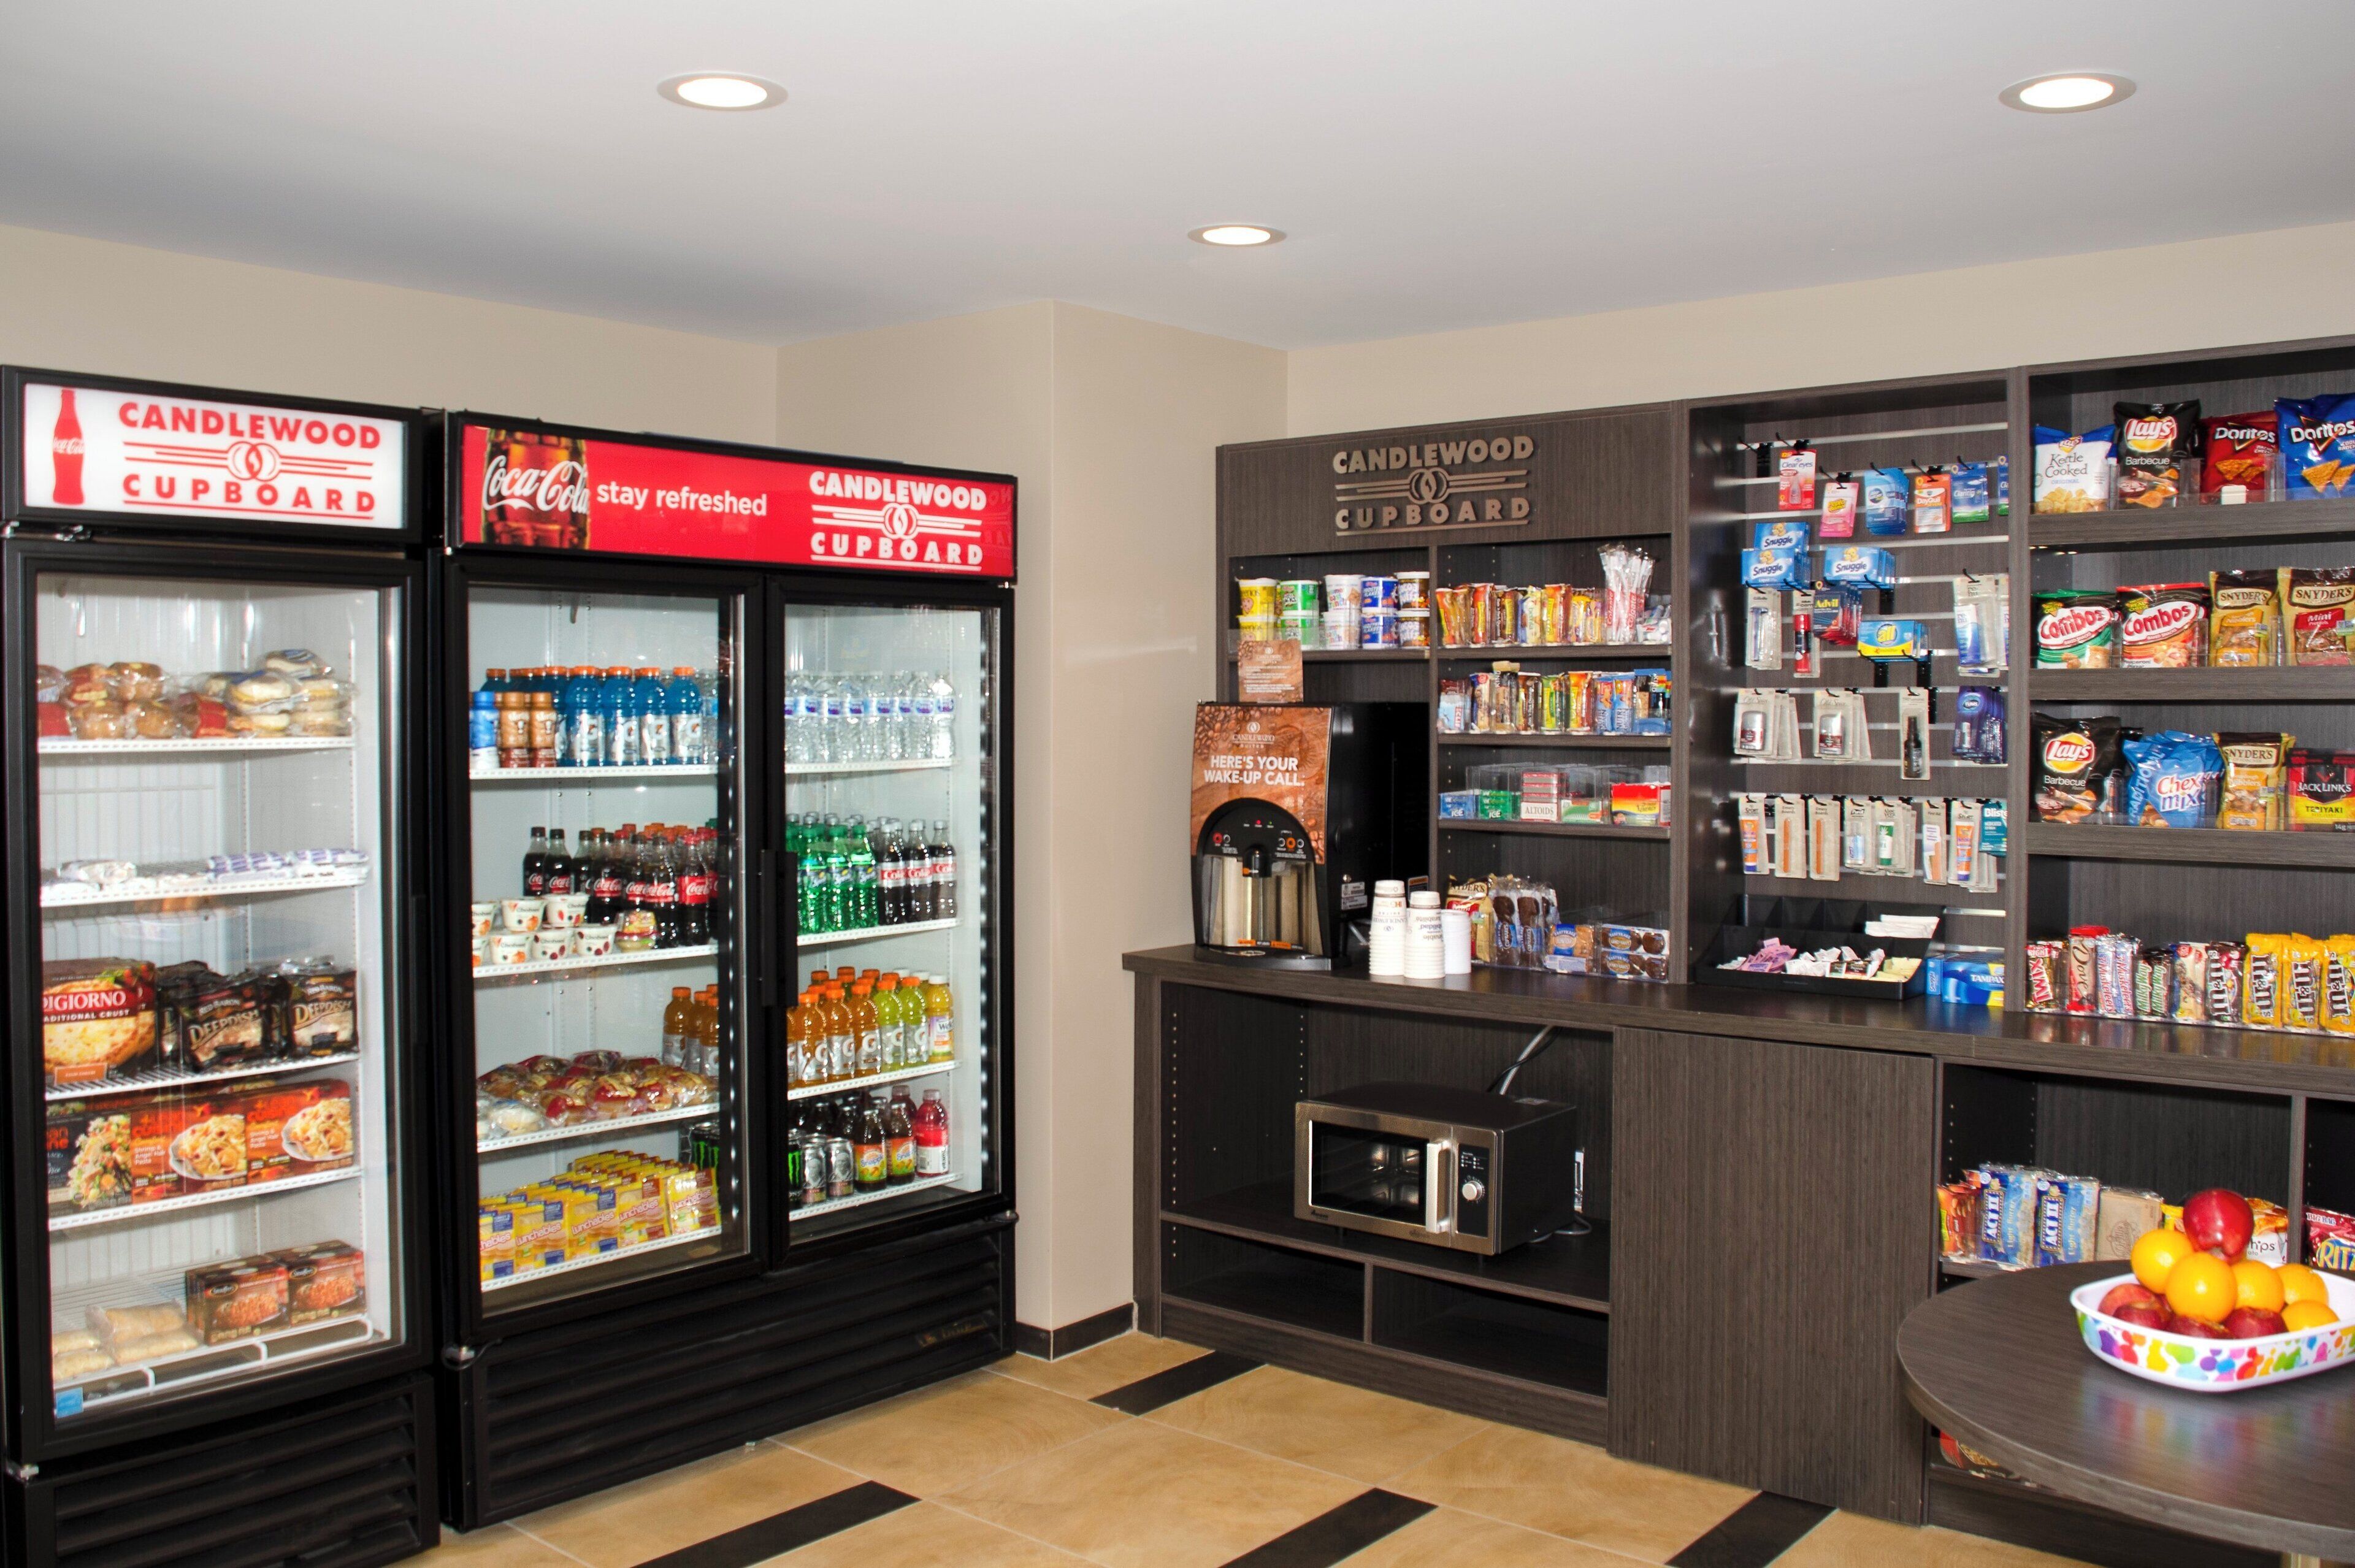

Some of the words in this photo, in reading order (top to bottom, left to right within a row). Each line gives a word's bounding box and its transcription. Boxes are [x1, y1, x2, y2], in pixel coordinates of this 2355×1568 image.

[118, 402, 381, 449] CANDLEWOOD
[2126, 419, 2173, 440] Lay's
[2215, 426, 2276, 443] Doritos
[2290, 420, 2355, 443] Doritos
[1333, 436, 1533, 474] CANDLEWOOD
[2050, 453, 2084, 468] Kettle
[2126, 456, 2170, 466] Barbecue
[2045, 467, 2088, 478] Cooked
[123, 473, 375, 512] CUPBOARD
[483, 455, 590, 514] Coca-Cola
[809, 471, 987, 511] CANDLEWOOD
[597, 484, 648, 511] stay
[656, 489, 767, 517] refreshed
[1335, 497, 1530, 529] CUPBOARD
[811, 533, 982, 565] CUPBOARD
[1763, 536, 1793, 549] Snuggle
[1753, 563, 1783, 576] Snuggle
[1835, 562, 1867, 575] Snuggle
[1814, 598, 1839, 608] Advil
[2220, 591, 2269, 602] SNYDER'S
[2296, 587, 2352, 600] SNYDER'S
[2040, 609, 2105, 639] Combos
[2124, 604, 2191, 637] Combos
[2308, 612, 2332, 622] Mini
[1877, 624, 1897, 643] all
[2047, 740, 2092, 762] Lay's
[2224, 748, 2273, 760] SNYDER'S
[1211, 755, 1254, 770] HERE'S
[1257, 757, 1299, 771] YOUR
[1203, 770, 1262, 785] WAKE-UP
[1264, 771, 1305, 787] CALL.
[2044, 774, 2086, 787] Barbecue
[2156, 771, 2203, 797] Chex
[2297, 782, 2321, 792] JACK
[2321, 783, 2353, 793] LINK'S
[1488, 810, 1502, 819] ICE
[1970, 974, 2005, 984] TAMPAX
[2029, 957, 2053, 1004] TWIX
[2098, 961, 2115, 1013] Musketeers
[99, 1009, 130, 1019] CRUST
[672, 1188, 711, 1211] Lunchables
[572, 1211, 615, 1236] Lunchables
[1986, 1209, 1999, 1239] ACT
[2307, 1212, 2321, 1221] BIG
[2322, 1215, 2337, 1225] BAG
[516, 1222, 562, 1247] Lunchables
[2045, 1215, 2059, 1246] ACT
[2067, 1233, 2078, 1256] Light
